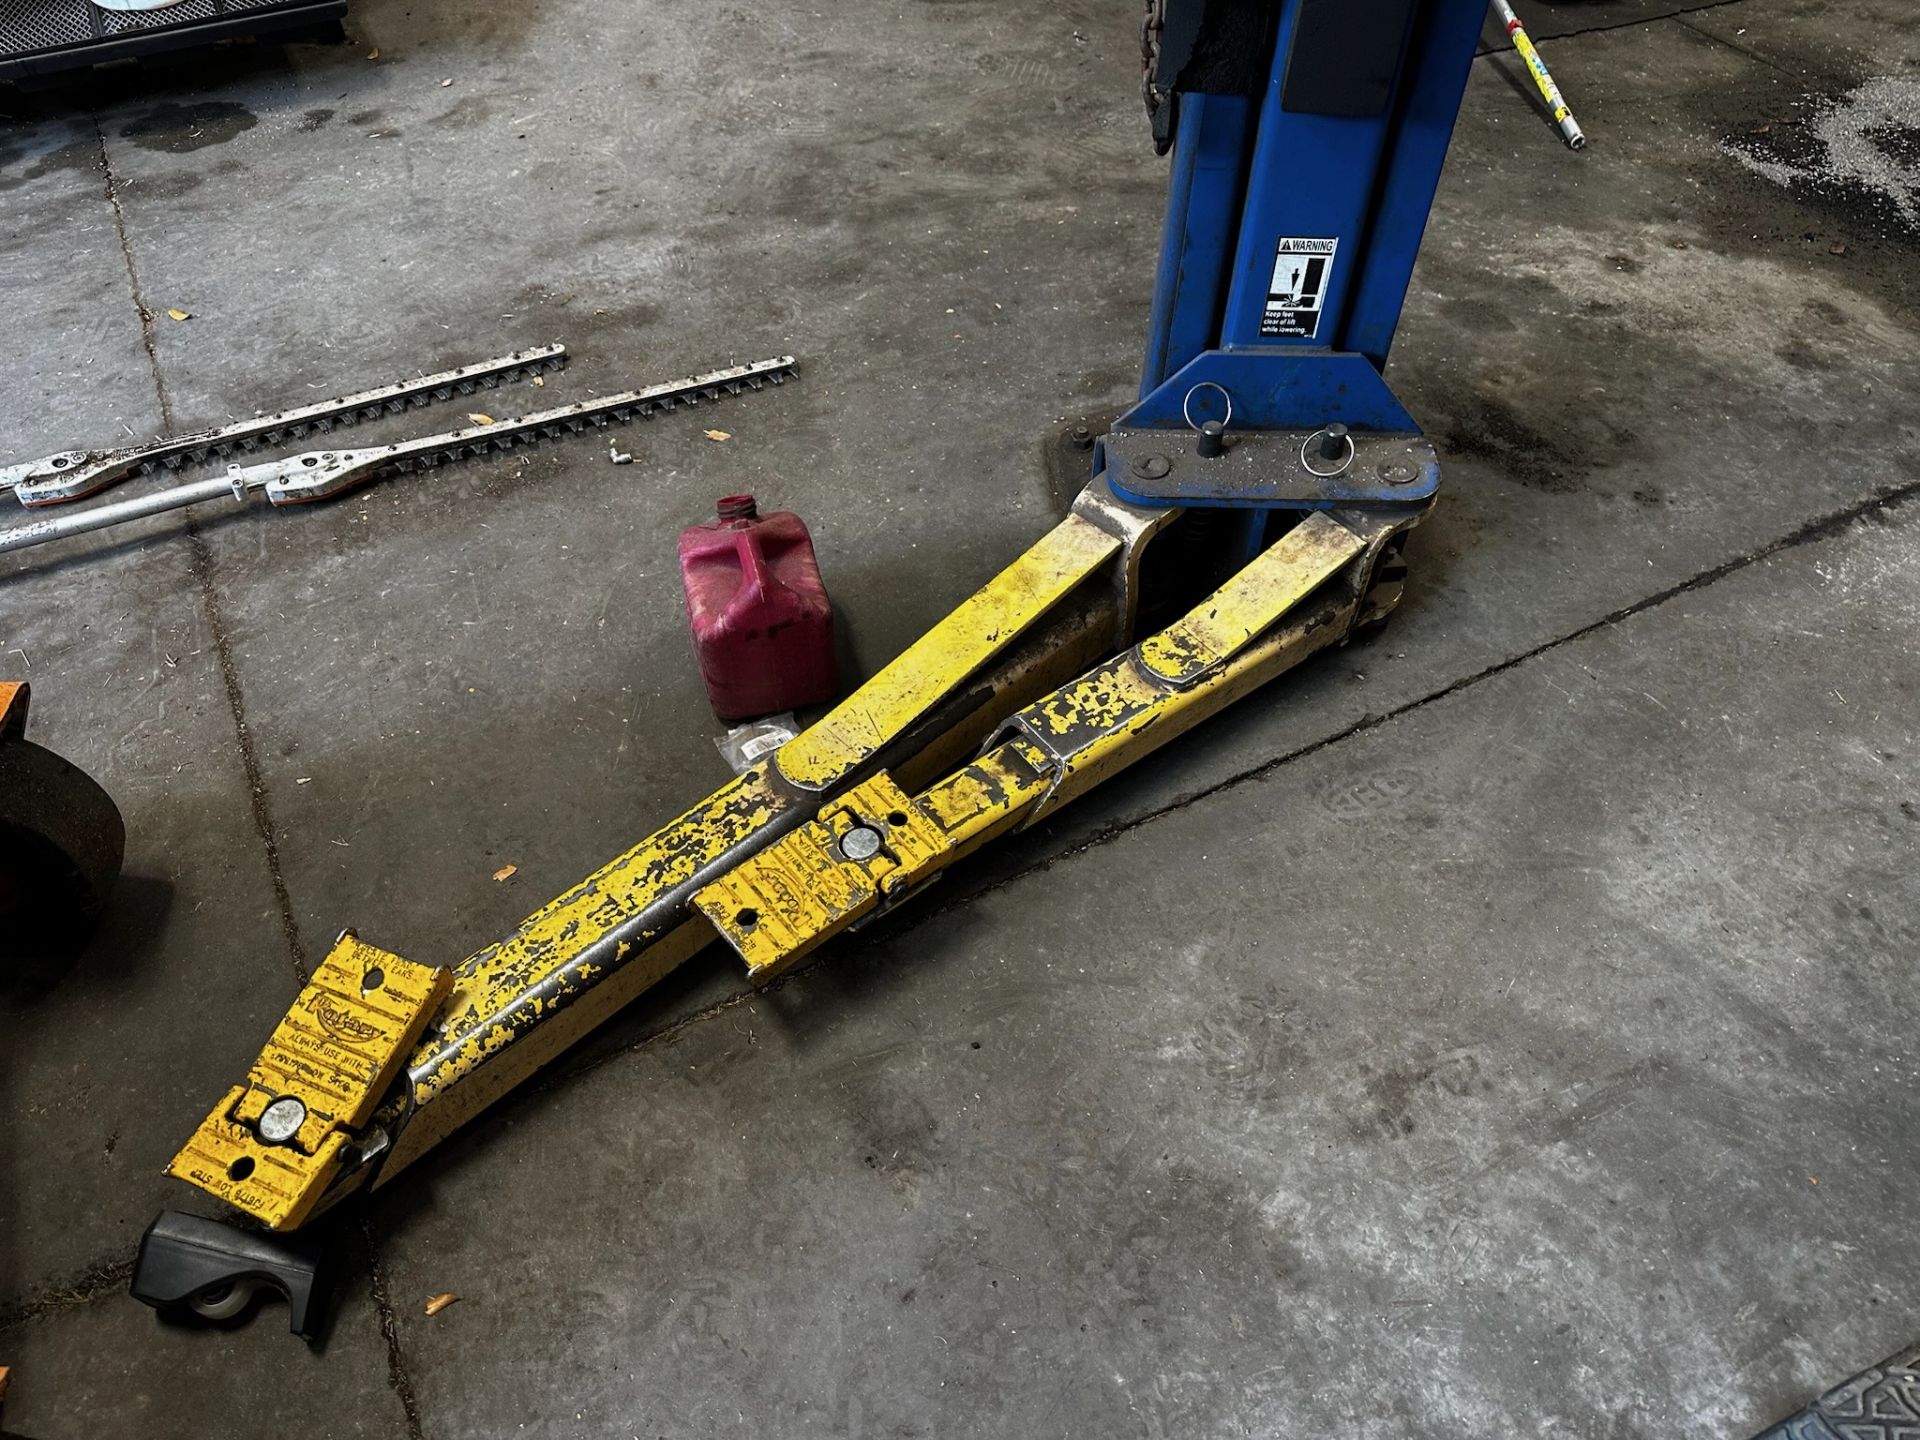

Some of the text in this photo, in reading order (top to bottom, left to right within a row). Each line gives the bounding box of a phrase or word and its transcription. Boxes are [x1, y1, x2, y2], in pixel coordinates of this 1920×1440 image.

[1292, 240, 1333, 252] WARNING
[1265, 311, 1281, 319] Keep
[287, 1033, 364, 1069] ALWAYS USE WITH
